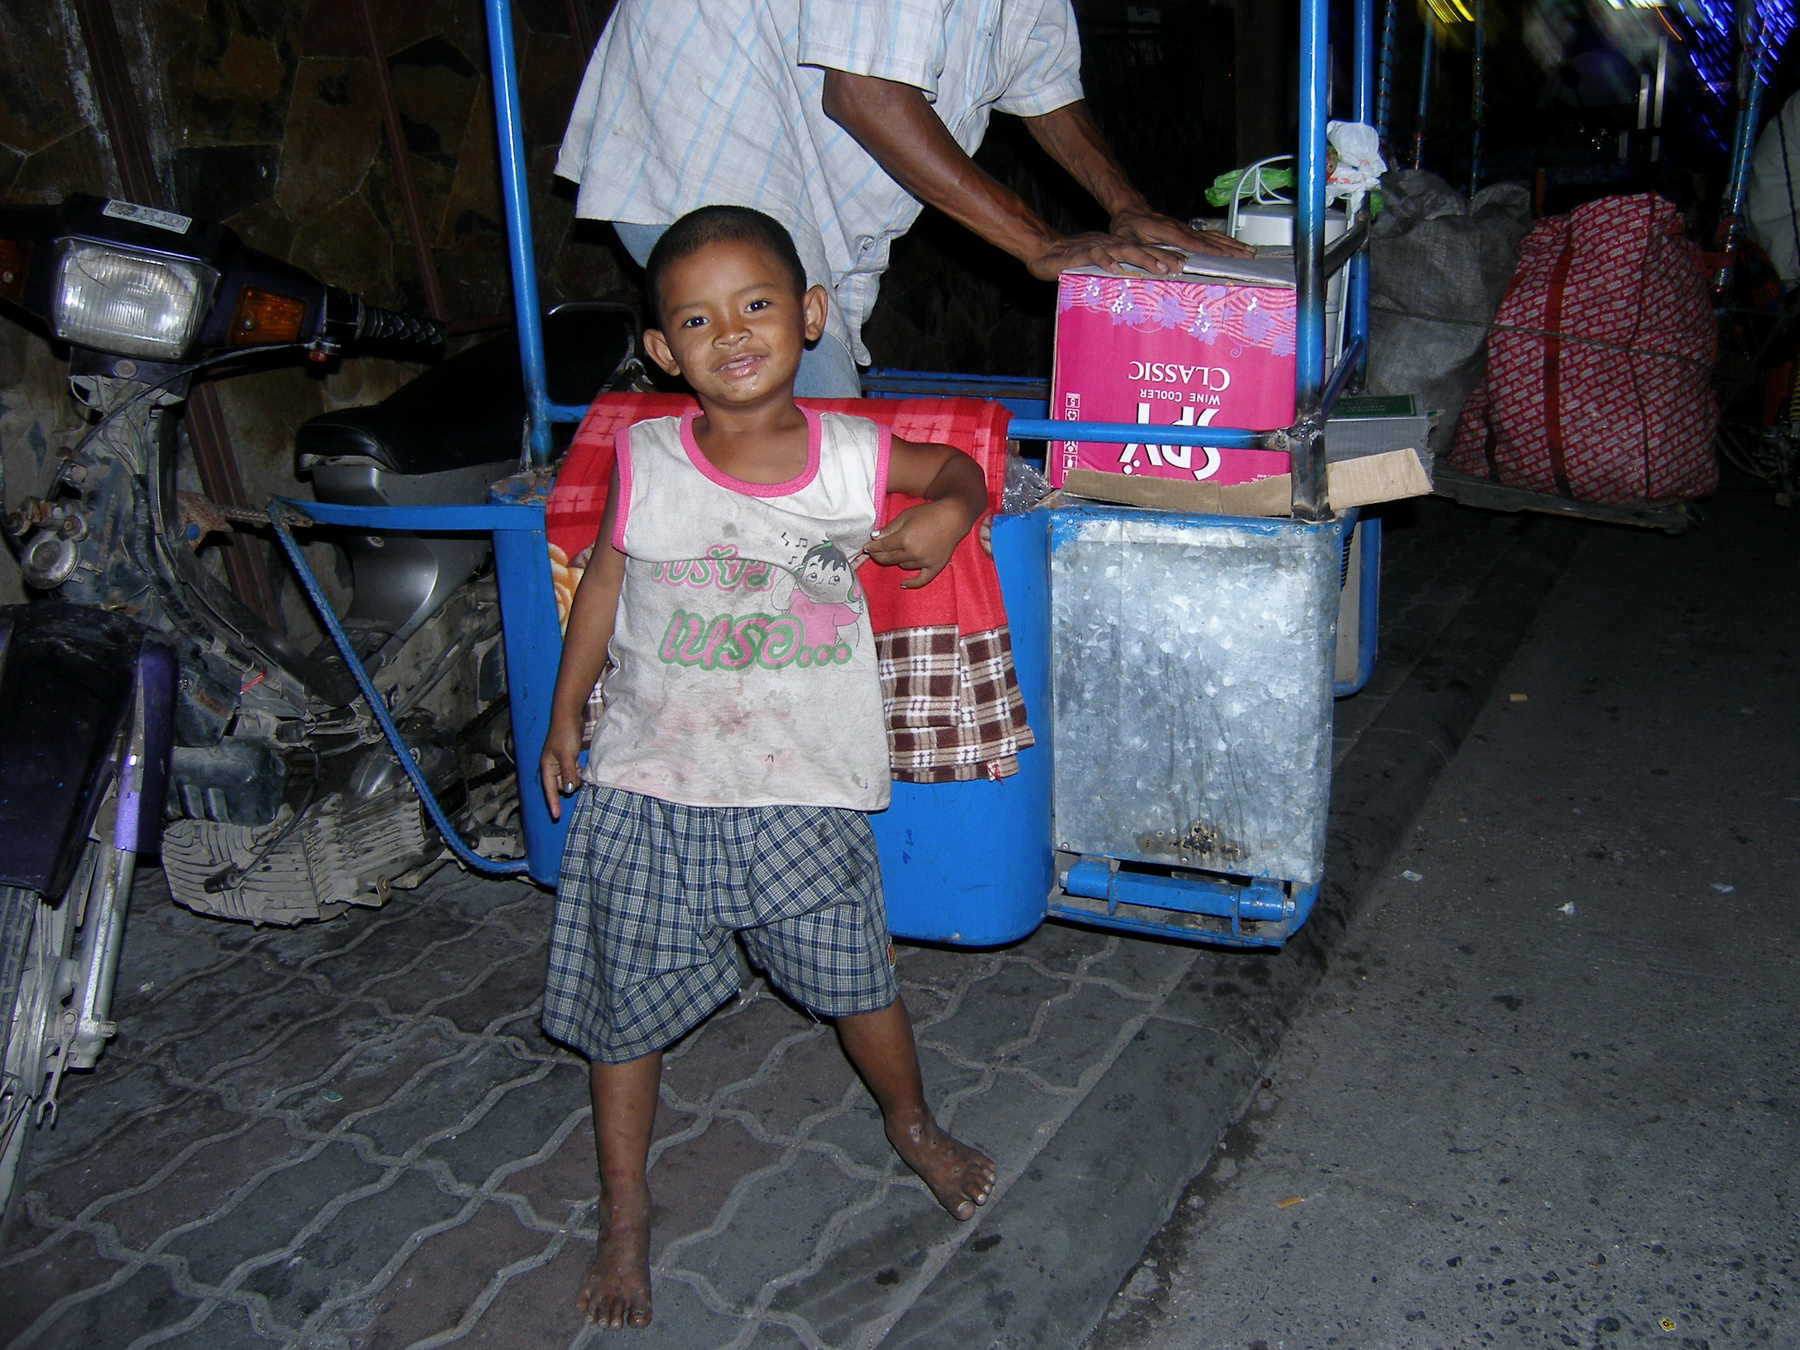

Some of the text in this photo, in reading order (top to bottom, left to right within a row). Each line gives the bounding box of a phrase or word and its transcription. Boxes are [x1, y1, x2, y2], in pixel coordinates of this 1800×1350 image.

[1128, 361, 1231, 392] CLASSIC
[1140, 389, 1221, 406] WINE COOLER
[1117, 402, 1221, 481] SPY
